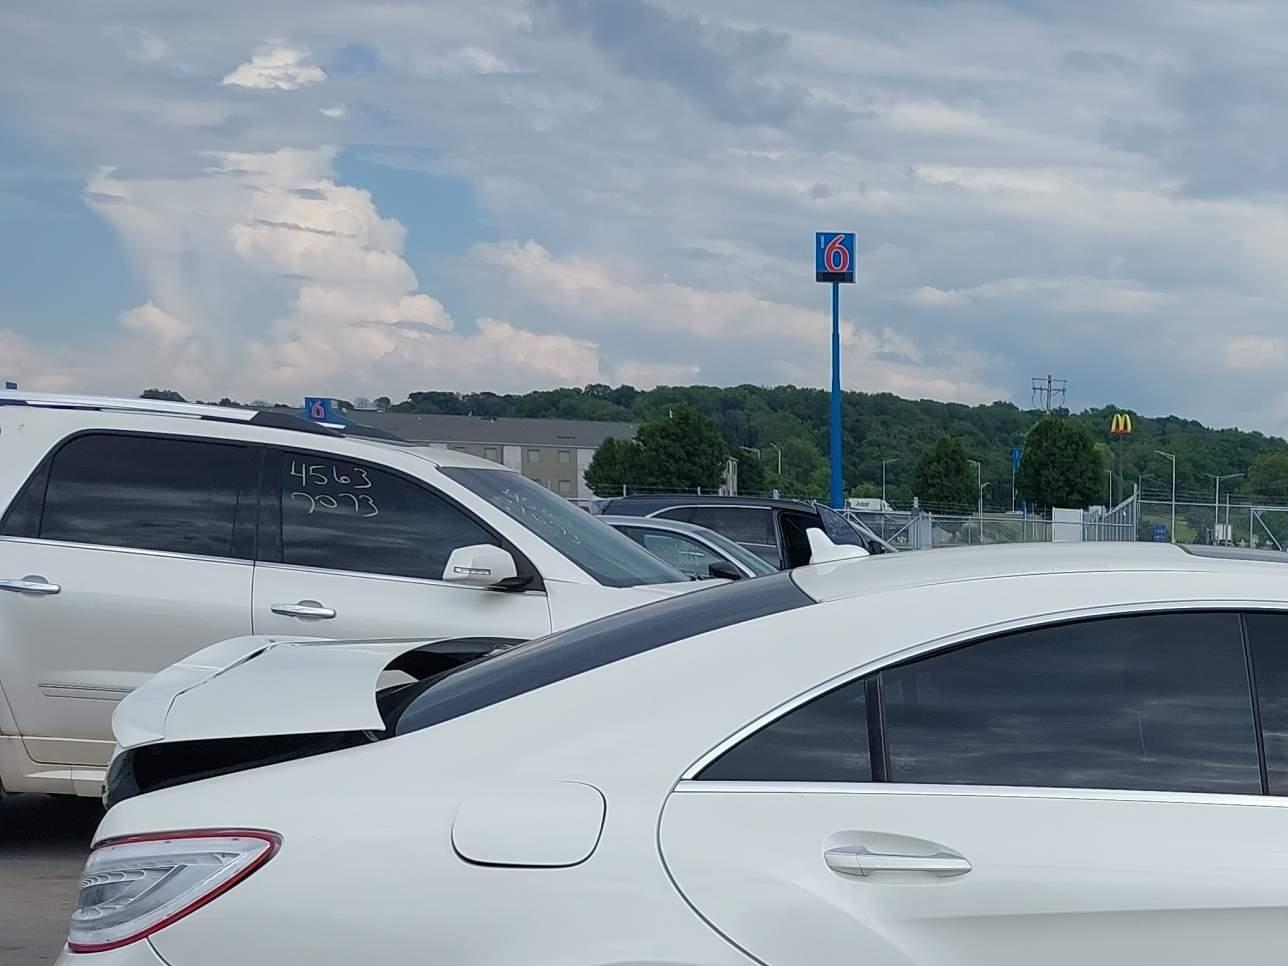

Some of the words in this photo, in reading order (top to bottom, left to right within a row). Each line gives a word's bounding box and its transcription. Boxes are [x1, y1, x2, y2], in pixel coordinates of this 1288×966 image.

[824, 234, 850, 272] 6
[311, 400, 325, 419] 6
[290, 460, 373, 489] 4563
[291, 491, 380, 518] 7073
